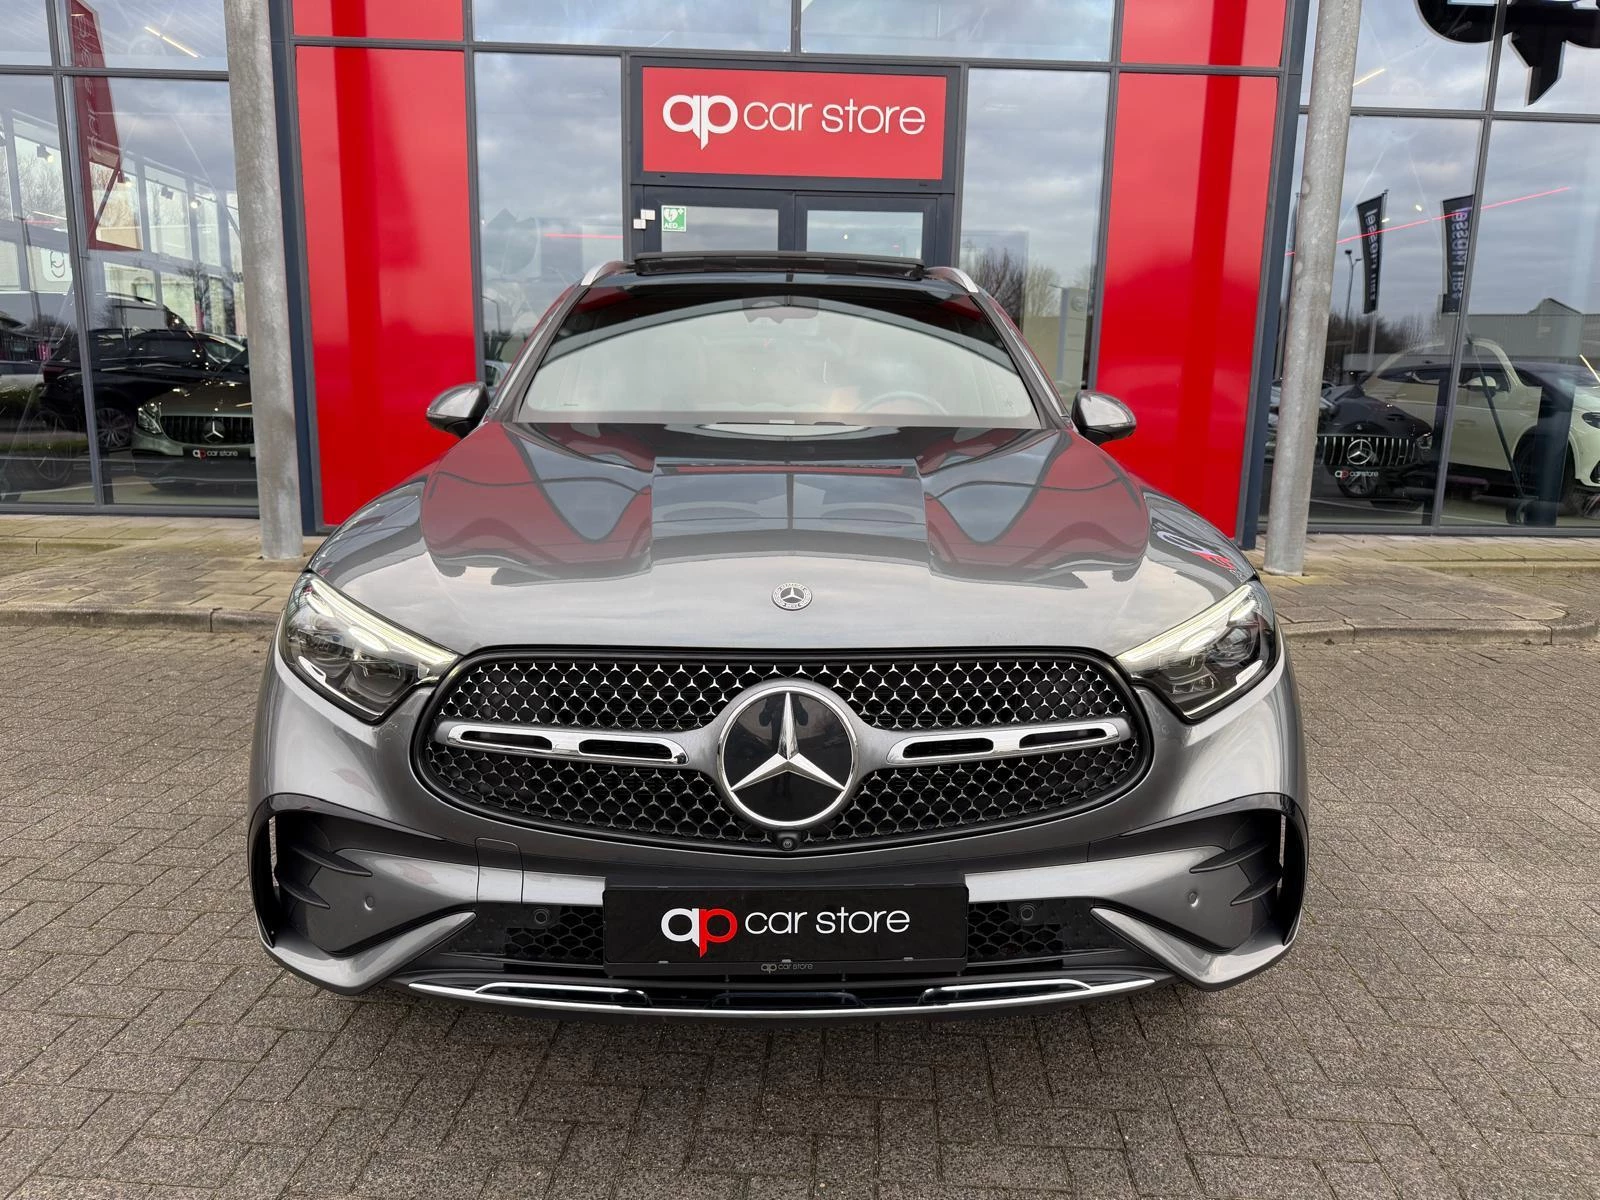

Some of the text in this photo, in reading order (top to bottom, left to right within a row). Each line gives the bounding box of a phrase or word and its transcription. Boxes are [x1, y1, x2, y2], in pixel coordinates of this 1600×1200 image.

[743, 101, 812, 131] car
[821, 98, 926, 135] store
[744, 911, 808, 935] car
[815, 906, 911, 934] store
